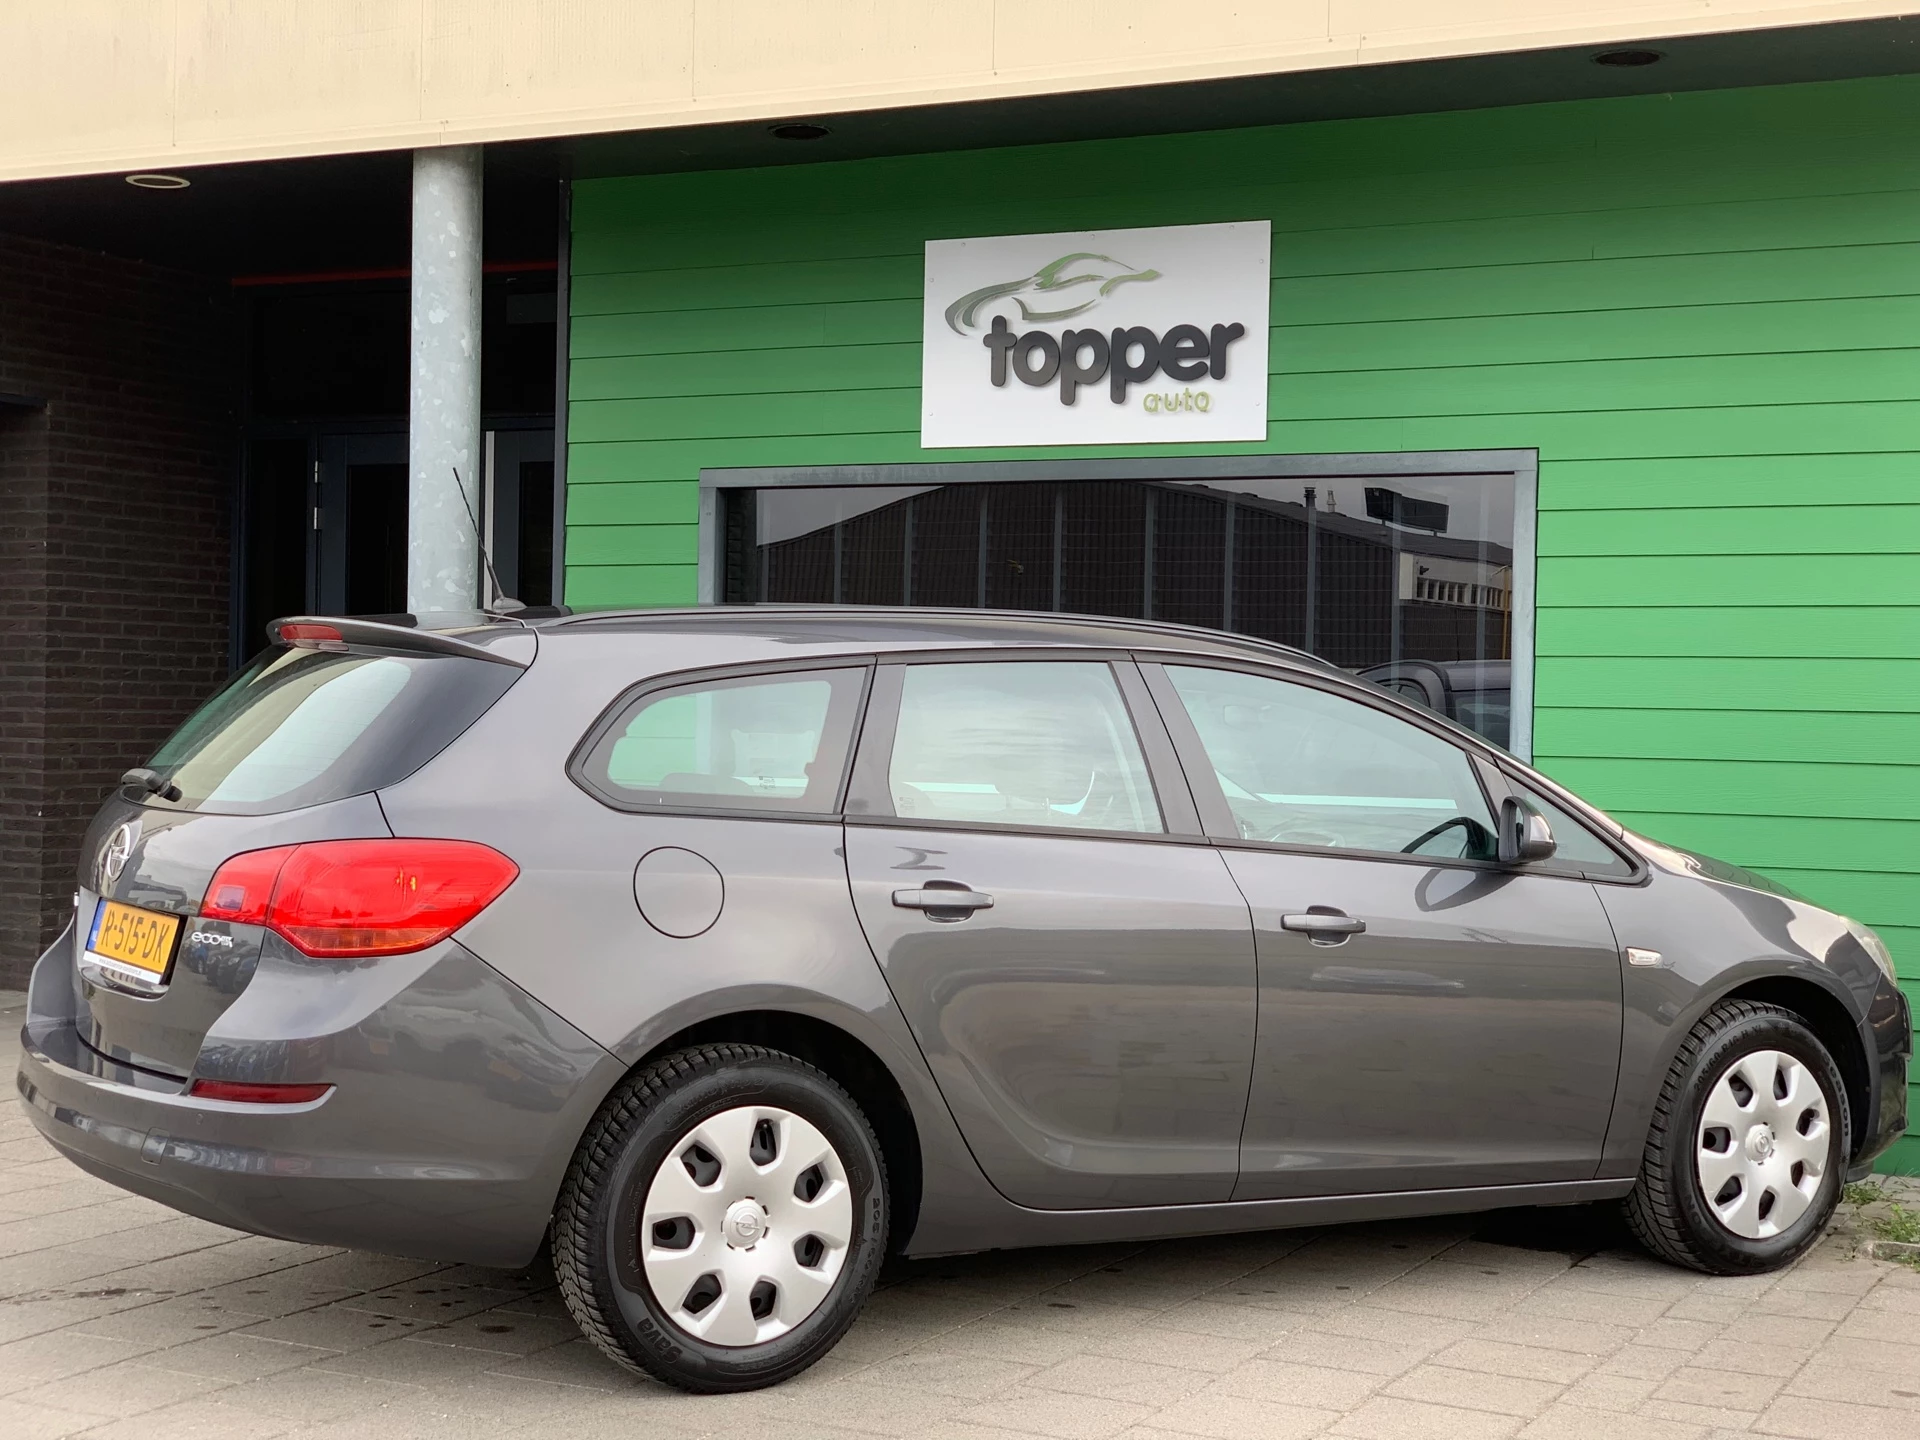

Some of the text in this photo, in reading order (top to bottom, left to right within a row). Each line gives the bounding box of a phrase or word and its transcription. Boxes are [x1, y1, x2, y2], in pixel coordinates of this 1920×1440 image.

[983, 315, 1245, 406] topper
[1143, 388, 1210, 412] auto
[101, 910, 170, 963] R-515-DK
[637, 1318, 683, 1363] Sava
